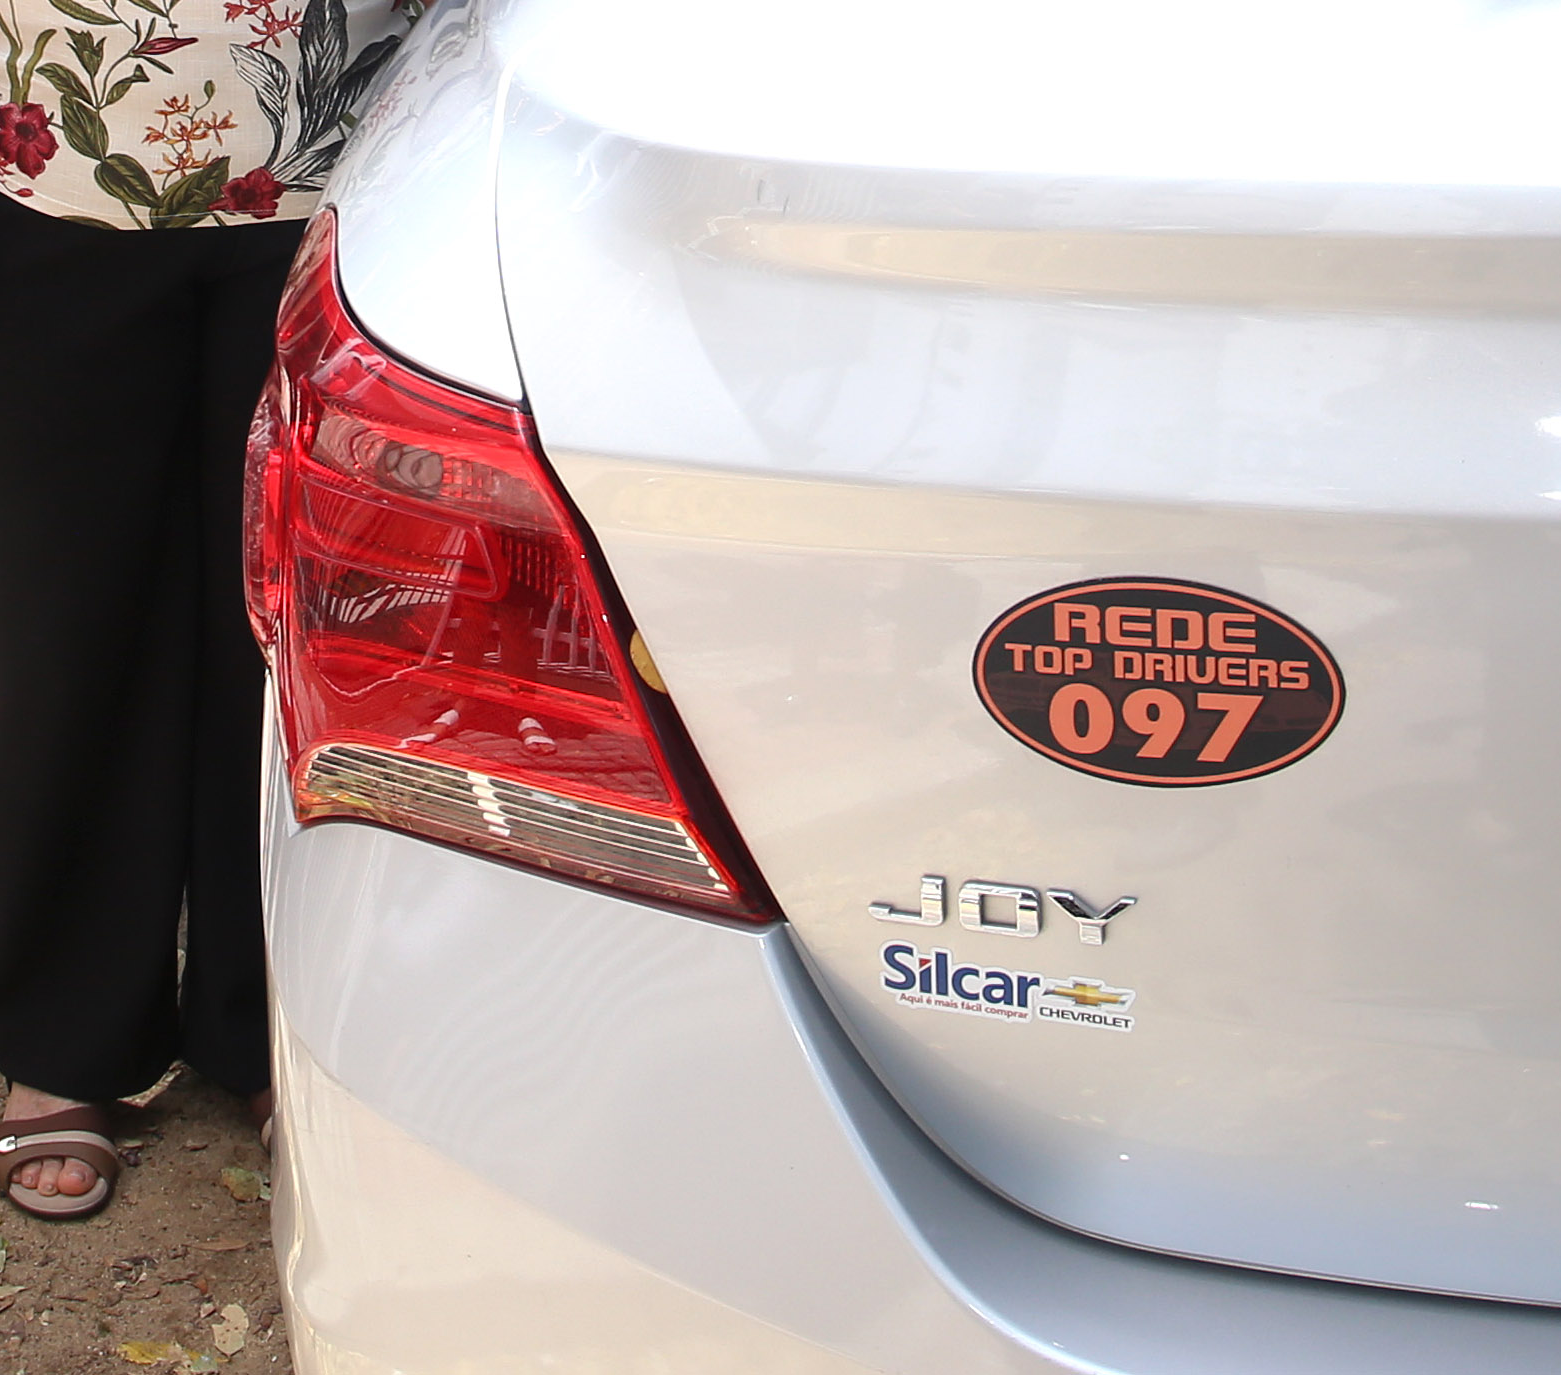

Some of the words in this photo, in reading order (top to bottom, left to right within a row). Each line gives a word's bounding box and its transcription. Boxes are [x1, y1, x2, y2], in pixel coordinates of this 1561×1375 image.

[1053, 602, 1257, 654] REDE
[1004, 642, 1093, 679] TOP
[1114, 650, 1309, 690] DRIVERS
[1048, 682, 1264, 763] 097
[867, 873, 1138, 946] JOY
[883, 944, 1041, 1009] Silcar
[899, 992, 924, 1005] Aqui
[925, 995, 933, 1005] é
[934, 999, 959, 1009] mais
[960, 1001, 983, 1014] fácil
[984, 1006, 1030, 1020] comprar
[1039, 1006, 1133, 1029] CHEVROLET
